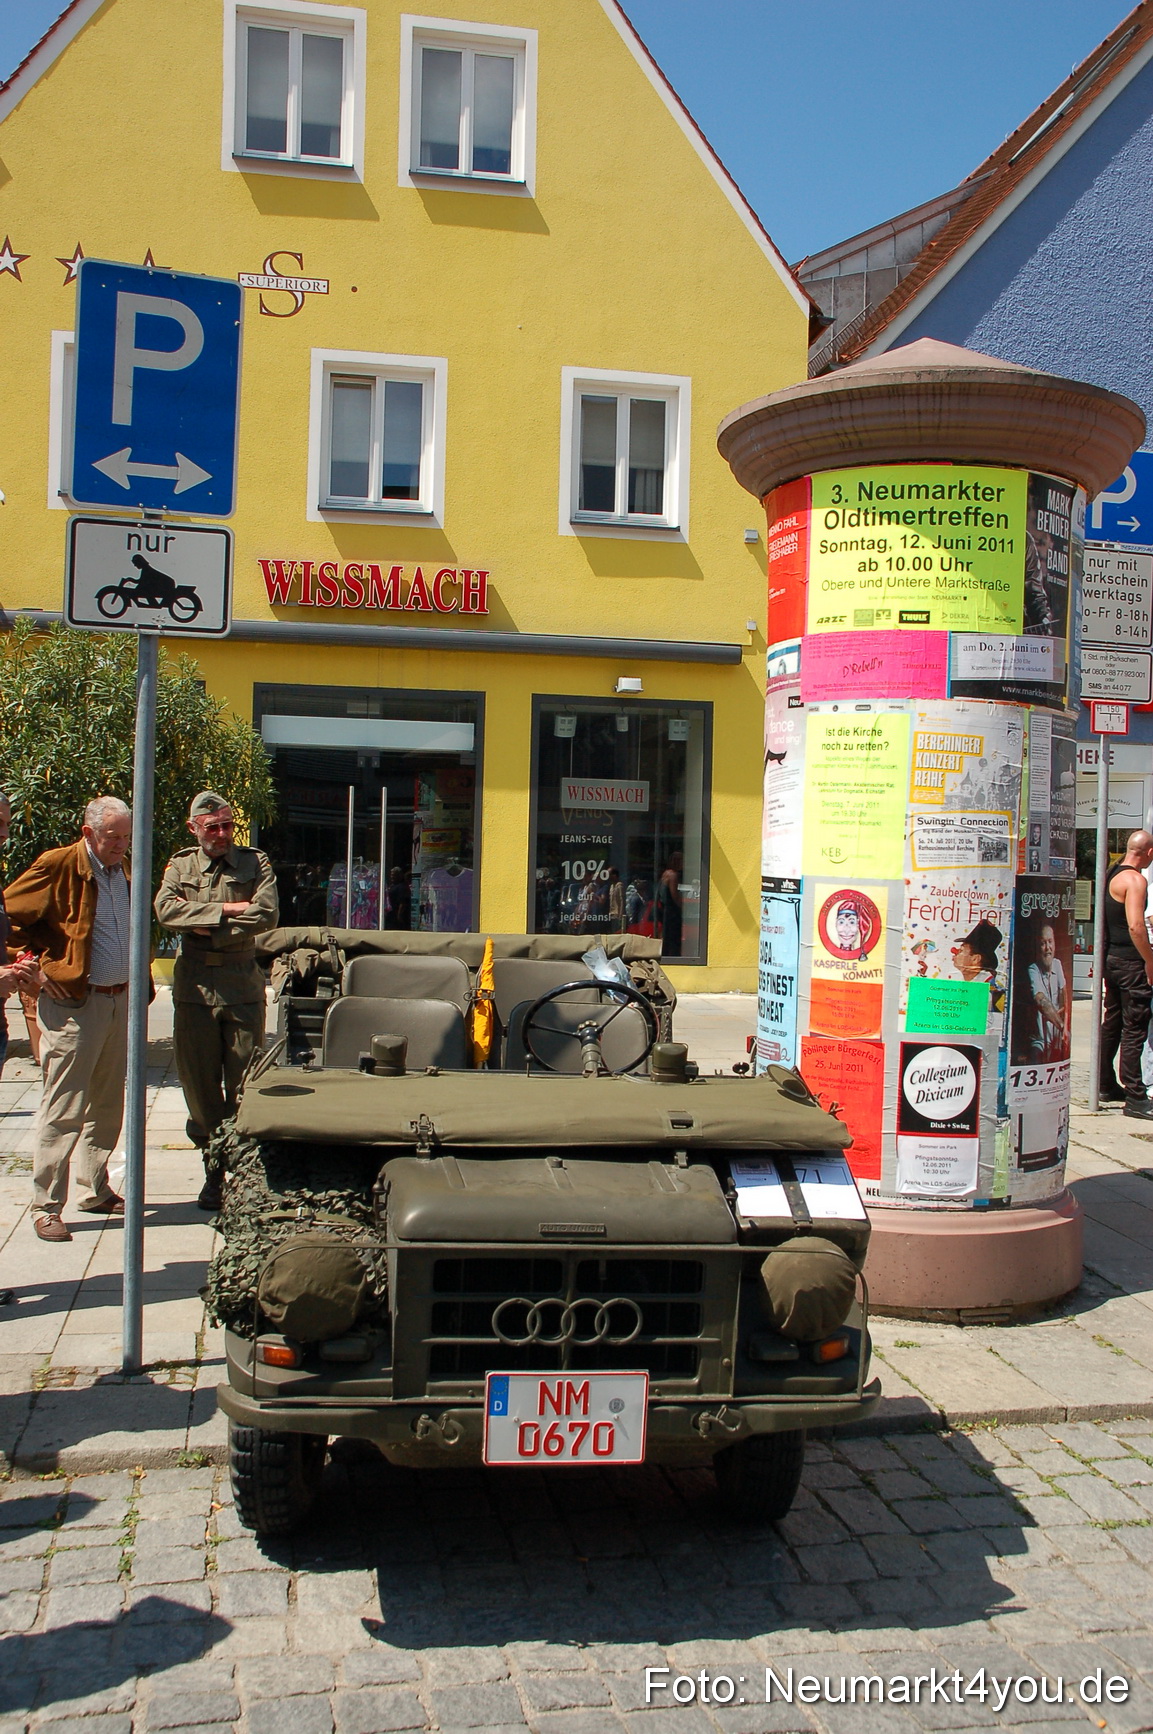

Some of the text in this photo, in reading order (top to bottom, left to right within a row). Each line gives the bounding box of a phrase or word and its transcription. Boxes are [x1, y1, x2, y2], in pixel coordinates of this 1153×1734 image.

[247, 275, 322, 292] SUPERIOR
[112, 290, 204, 426] P
[831, 480, 1006, 504] 3. Neumarkter
[1047, 489, 1071, 517] MARK
[824, 505, 1009, 530] Oldtimertreffen
[1037, 510, 1069, 540] BENDER
[126, 530, 176, 553] nur
[819, 534, 1015, 554] Sonntag, 12. Juni 2011
[858, 556, 974, 572] ab 10.00 Uhr
[1047, 549, 1068, 576] BAND
[1089, 557, 1138, 572] nur mit
[257, 558, 490, 615] WISSMACH
[821, 576, 1011, 592] Obere und Untere Marktstraße
[1083, 588, 1142, 605] werktags
[979, 642, 996, 652] Do.
[999, 642, 1007, 652] 2.
[1009, 643, 1029, 653] Juni
[1030, 645, 1039, 653] im
[1109, 654, 1138, 663] Parkschein
[1088, 682, 1102, 690] SMS
[1107, 705, 1120, 713] 150
[825, 727, 883, 737] Ist die Kirche
[821, 741, 890, 751] noch zu retten?
[917, 734, 981, 754] BERCHINGER
[916, 752, 961, 771] KONZERT
[914, 772, 945, 788] REIHE
[567, 784, 645, 803] WISSMACH
[960, 817, 1009, 827] Connection
[560, 835, 613, 844] JEANS-TAGE
[821, 847, 841, 858] KEB
[561, 859, 610, 881] 10%
[578, 892, 594, 901] auf
[930, 885, 989, 900] Zauberclown
[908, 897, 960, 922] Ferdi
[1021, 891, 1060, 918] gregg
[559, 911, 611, 923] jede Jeans!
[813, 958, 858, 971] KASPERLE
[843, 968, 883, 981] KOMMT!
[802, 1043, 882, 1065] Pöllinger Bürgerfest
[828, 1061, 844, 1070] Juni
[846, 1063, 864, 1073] 2011
[909, 1063, 968, 1085] Collegium
[915, 1084, 965, 1105] Dixicum
[952, 1122, 970, 1130] Swing
[542, 1224, 604, 1233] AUTO UNION
[494, 1400, 503, 1411] D
[537, 1380, 590, 1416] NM
[518, 1421, 616, 1457] 0670
